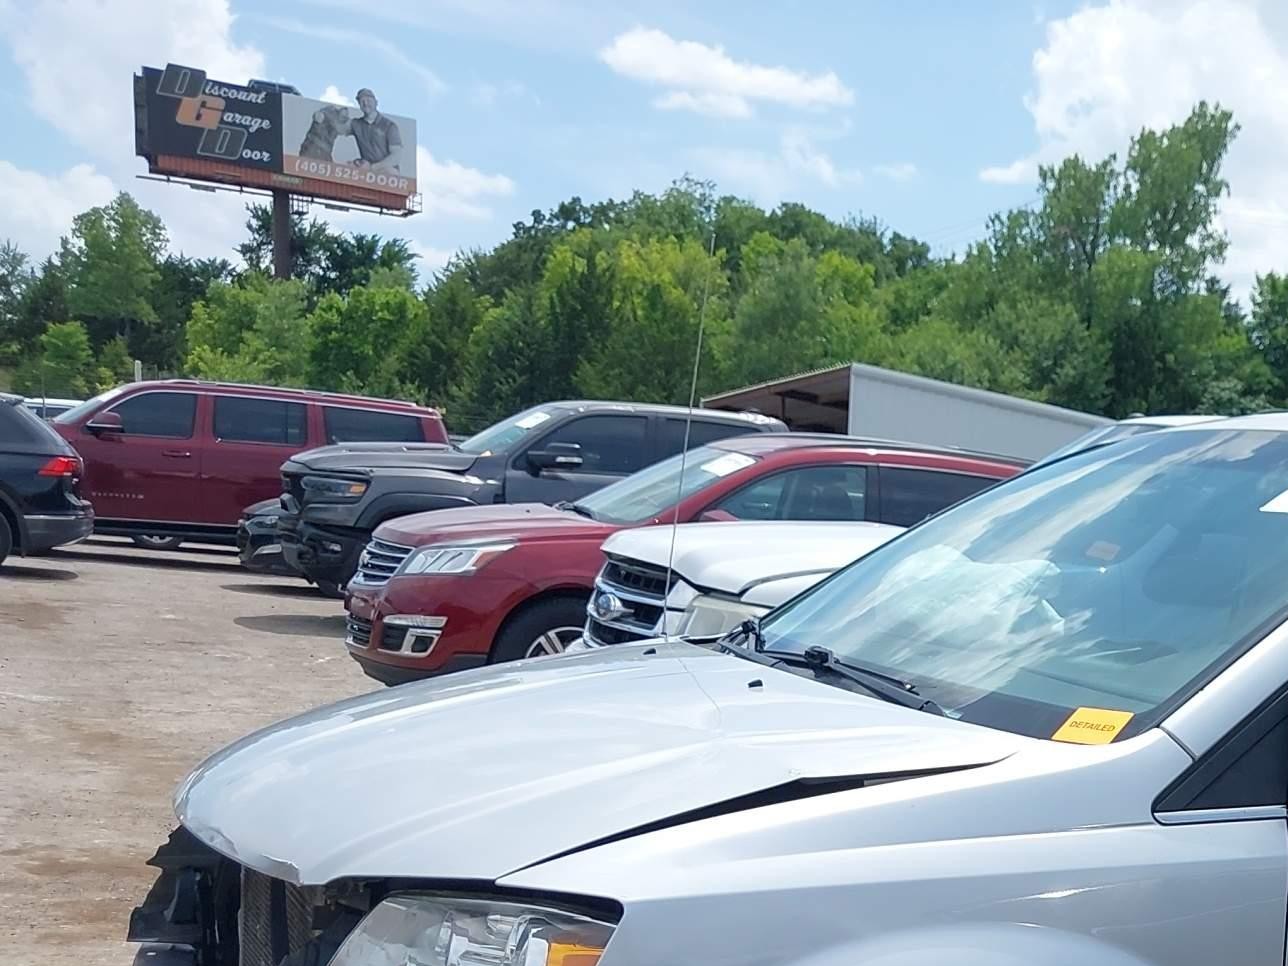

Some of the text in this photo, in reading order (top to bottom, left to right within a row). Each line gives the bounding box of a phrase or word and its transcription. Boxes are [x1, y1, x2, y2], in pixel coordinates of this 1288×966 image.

[156, 63, 267, 104] Discount
[175, 96, 272, 130] Garage
[197, 124, 272, 162] Door
[294, 158, 409, 191] (405) 525-DOOR
[1069, 720, 1116, 732] DETAILED
